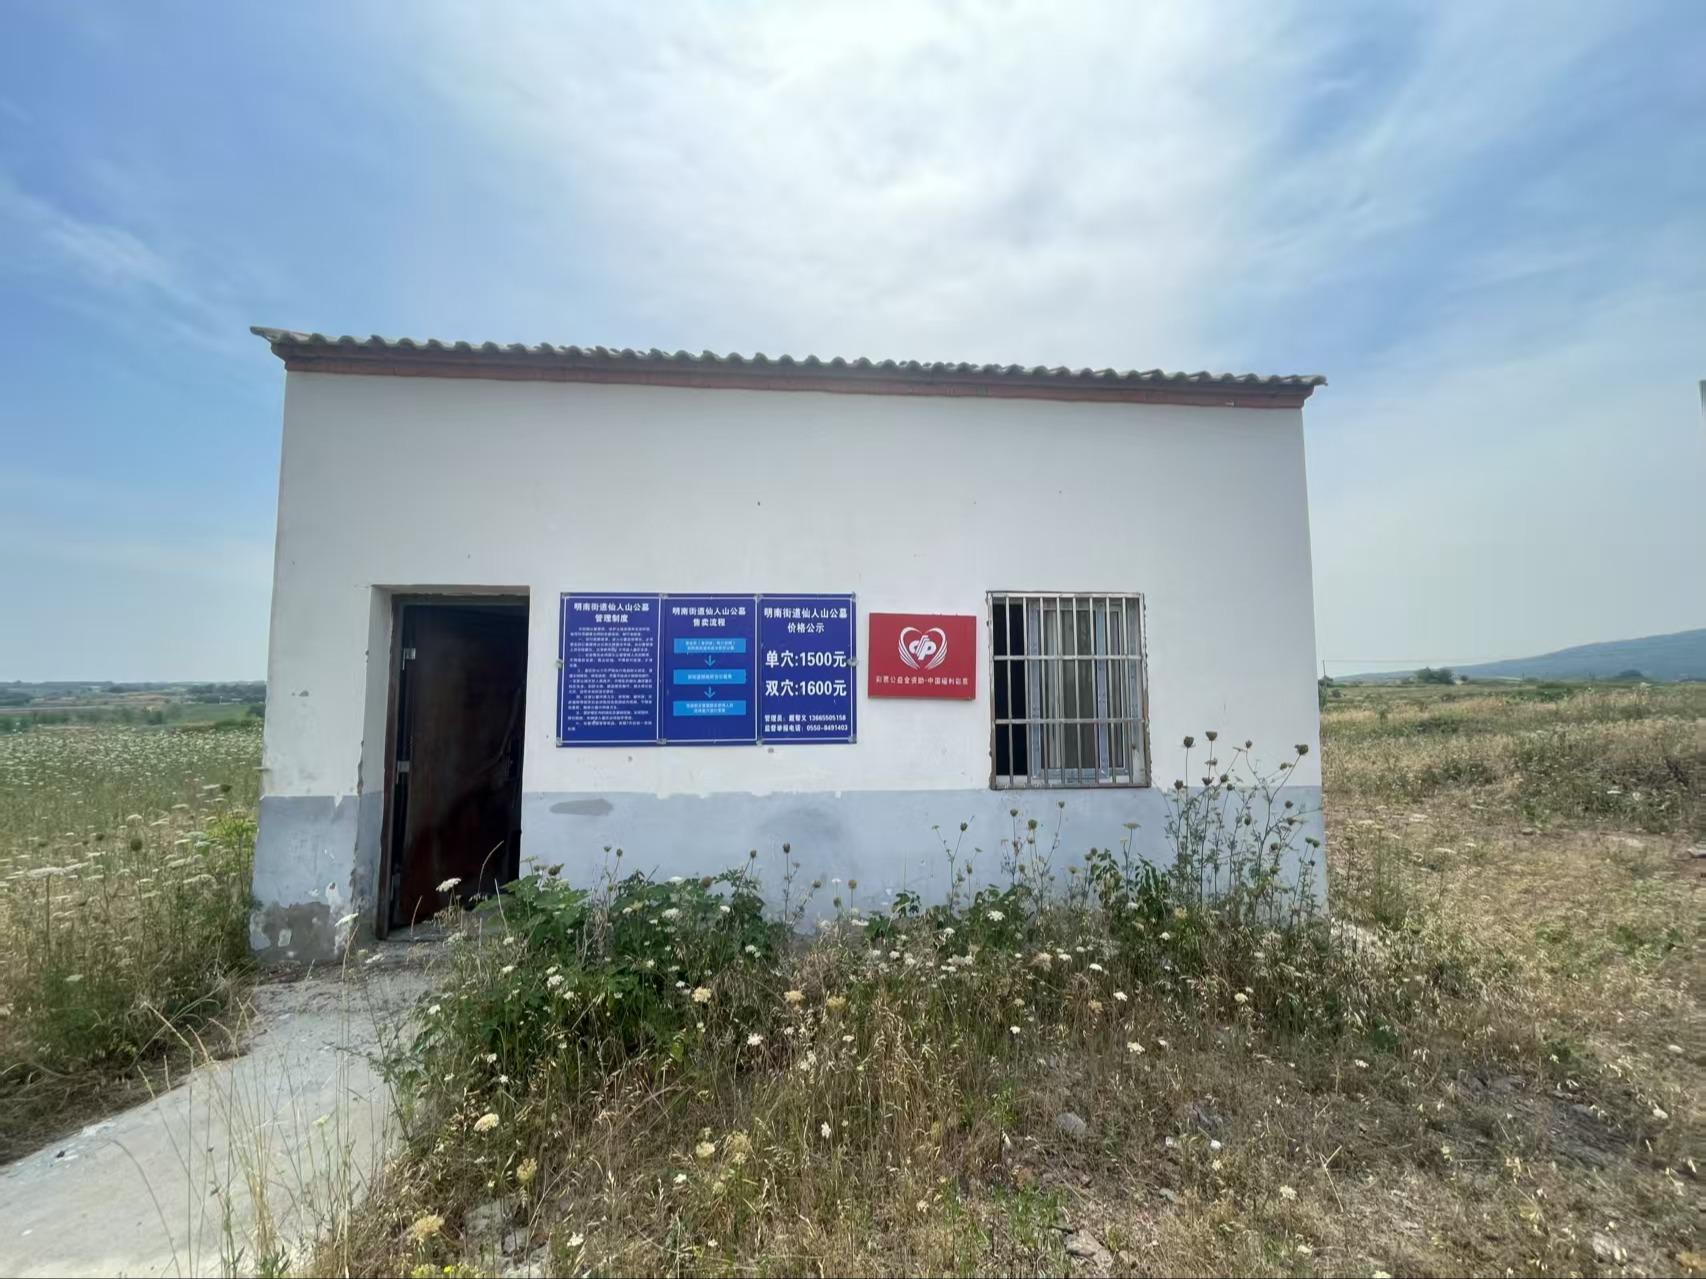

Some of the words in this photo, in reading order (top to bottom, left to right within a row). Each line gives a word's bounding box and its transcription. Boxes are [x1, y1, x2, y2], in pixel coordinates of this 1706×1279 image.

[574, 602, 650, 612] 明南街道仙人山公墓
[672, 607, 746, 616] 明南街道仙人山公墓
[595, 614, 629, 623] 管理制度
[764, 607, 848, 619] 明南街道仙人山公墓
[693, 618, 726, 627] 售卖流程
[787, 622, 825, 634] 价格公示
[765, 650, 847, 668] 单穴:1500元
[765, 679, 847, 697] 双穴:1600元
